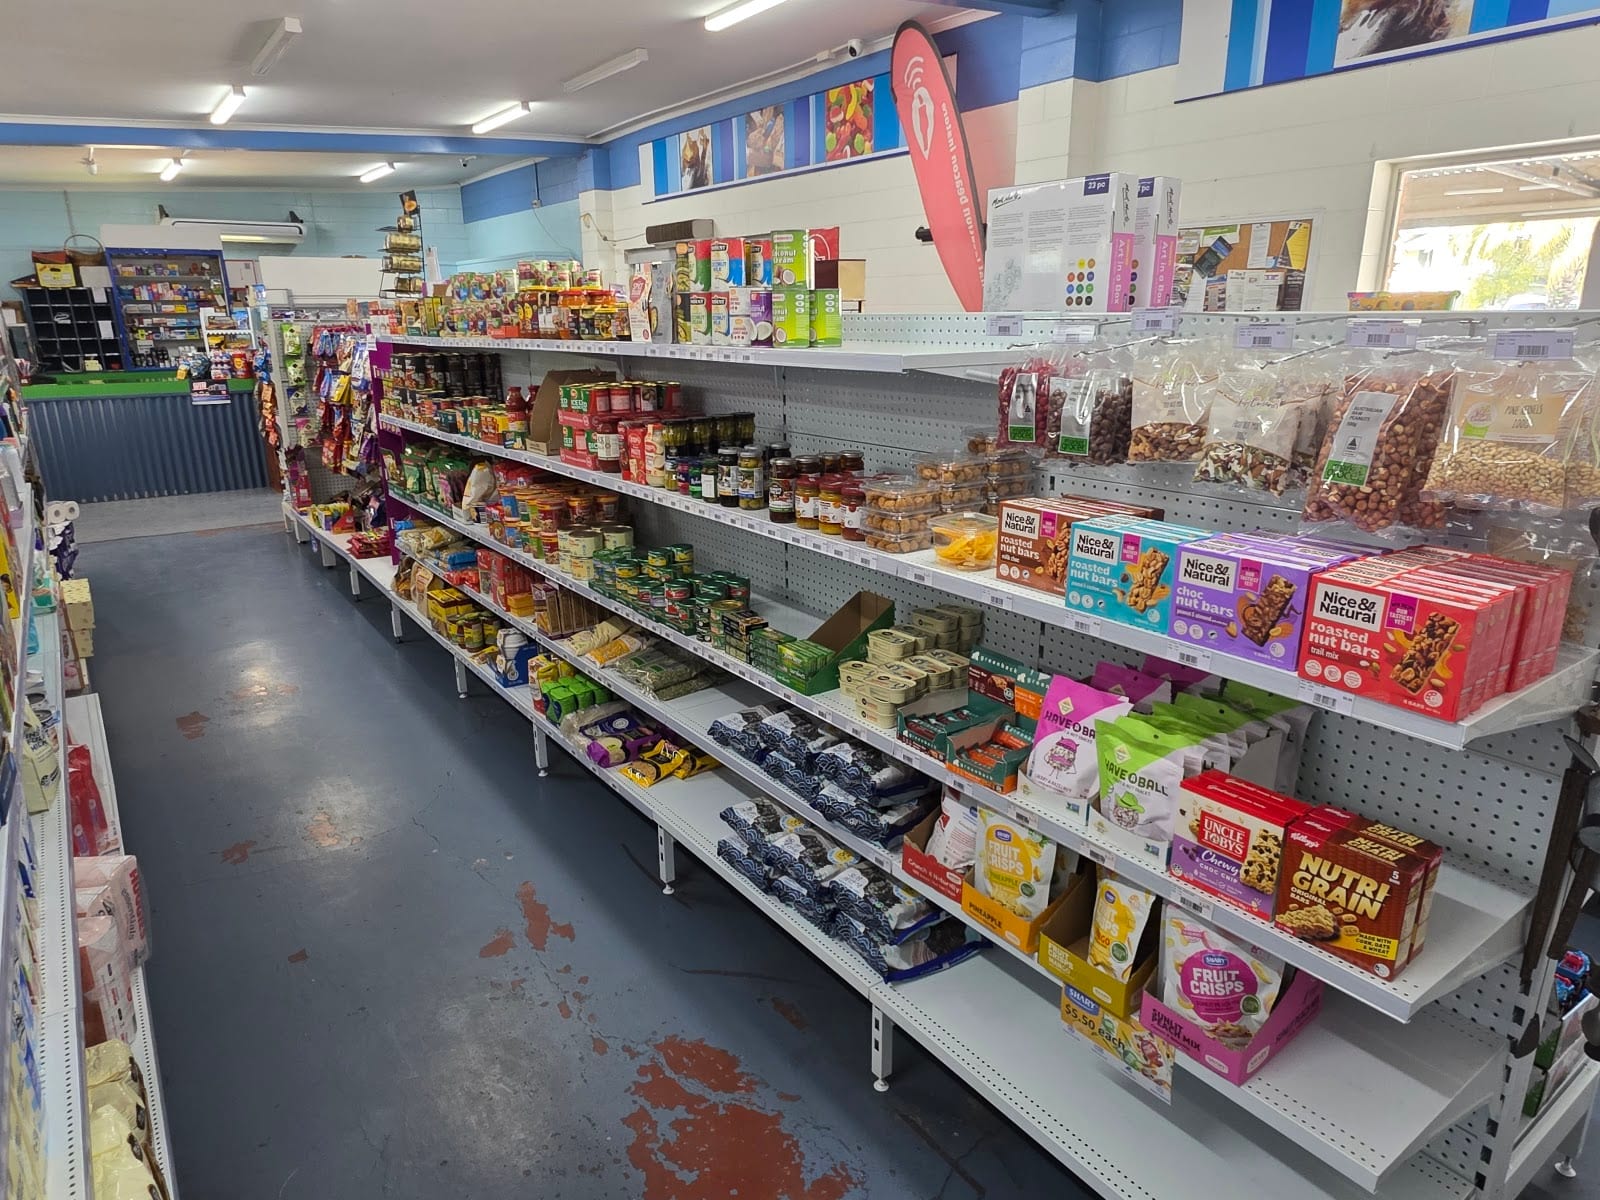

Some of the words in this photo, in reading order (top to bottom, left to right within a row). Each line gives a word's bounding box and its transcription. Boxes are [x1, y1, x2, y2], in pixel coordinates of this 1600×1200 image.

[1087, 181, 1097, 189] 23
[1117, 239, 1126, 257] Art
[1160, 241, 1169, 258] Art
[1113, 284, 1123, 304] Box
[1156, 284, 1165, 304] Box
[1004, 520, 1036, 534] Natural
[1006, 512, 1025, 524] Nice
[1025, 515, 1036, 525] &
[1000, 535, 1033, 549] roasted
[1076, 543, 1115, 560] Natural
[1078, 534, 1101, 547] Nice
[1101, 538, 1114, 550] &
[1000, 544, 1017, 554] nut
[1017, 547, 1040, 560] bars
[1070, 560, 1110, 575] roasted
[1186, 558, 1214, 573] Nice
[1214, 563, 1229, 576] &
[1070, 569, 1090, 581] nut
[1091, 573, 1119, 588] bars
[1183, 568, 1230, 587] Natural
[1176, 586, 1204, 600] choc
[1323, 590, 1357, 608] Nice
[1357, 597, 1377, 612] &
[1175, 595, 1199, 610] nut
[1201, 601, 1234, 618] bars
[1319, 601, 1377, 625] Natural
[1310, 621, 1369, 643] roasted
[1309, 631, 1337, 648] nut
[1340, 639, 1380, 660] bars
[1310, 646, 1324, 657] trail
[1325, 651, 1339, 660] mix
[1204, 818, 1245, 841] UNCLE
[1203, 828, 1244, 855] TOBYS
[1290, 832, 1320, 849] Kellogg's
[989, 840, 1020, 861] FRUIT
[988, 854, 1024, 875] CRISPS
[1201, 850, 1239, 876] Chewy
[1199, 863, 1219, 875] CHOC
[1220, 872, 1239, 883] CHIP
[1299, 850, 1391, 903] NUTRI
[1391, 870, 1400, 880] 5
[128, 868, 145, 940] HUGGIES
[1290, 886, 1327, 906] ORIGINAL
[1290, 892, 1310, 905] BARS
[1292, 871, 1383, 920] GRAIN
[969, 902, 1002, 929] PINEAPPLE
[1369, 947, 1390, 955] WHEAT
[1192, 967, 1240, 983] FRUIT
[1190, 980, 1245, 996] CRISPS
[1069, 988, 1096, 1009] SHARY
[1065, 1004, 1096, 1030] $5.50
[1098, 1026, 1126, 1050] each
